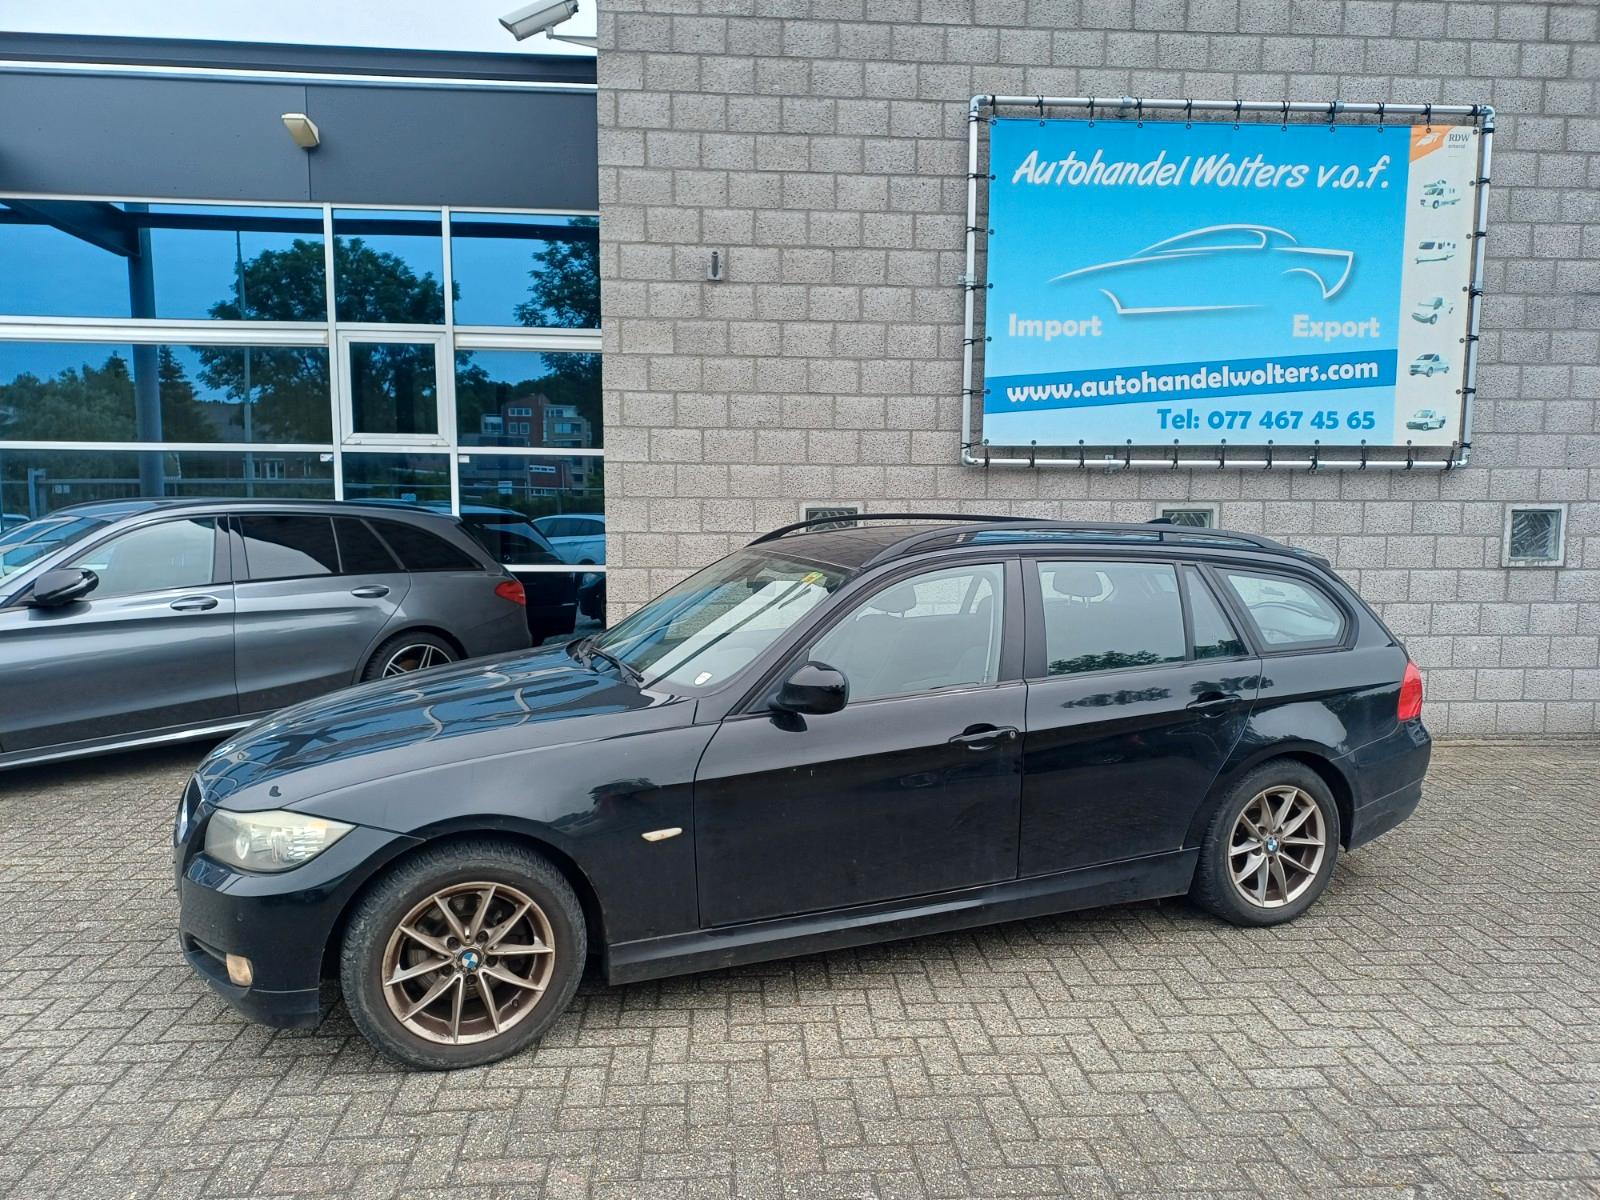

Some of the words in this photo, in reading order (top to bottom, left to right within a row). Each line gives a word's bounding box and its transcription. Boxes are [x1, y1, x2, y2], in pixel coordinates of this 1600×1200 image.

[1448, 133, 1470, 142] RDW
[1012, 149, 1191, 186] Autohandel
[1190, 153, 1309, 188] Wolters
[1316, 154, 1390, 189] v.o.f.
[1009, 312, 1102, 341] Import
[1292, 313, 1380, 341] Export
[1006, 361, 1378, 402] www.autohandelwolters.com
[1157, 408, 1200, 429] Tel:
[1207, 410, 1252, 430] 077
[1259, 410, 1303, 430] 467
[1310, 410, 1339, 430] 45
[1346, 410, 1375, 430] 65
